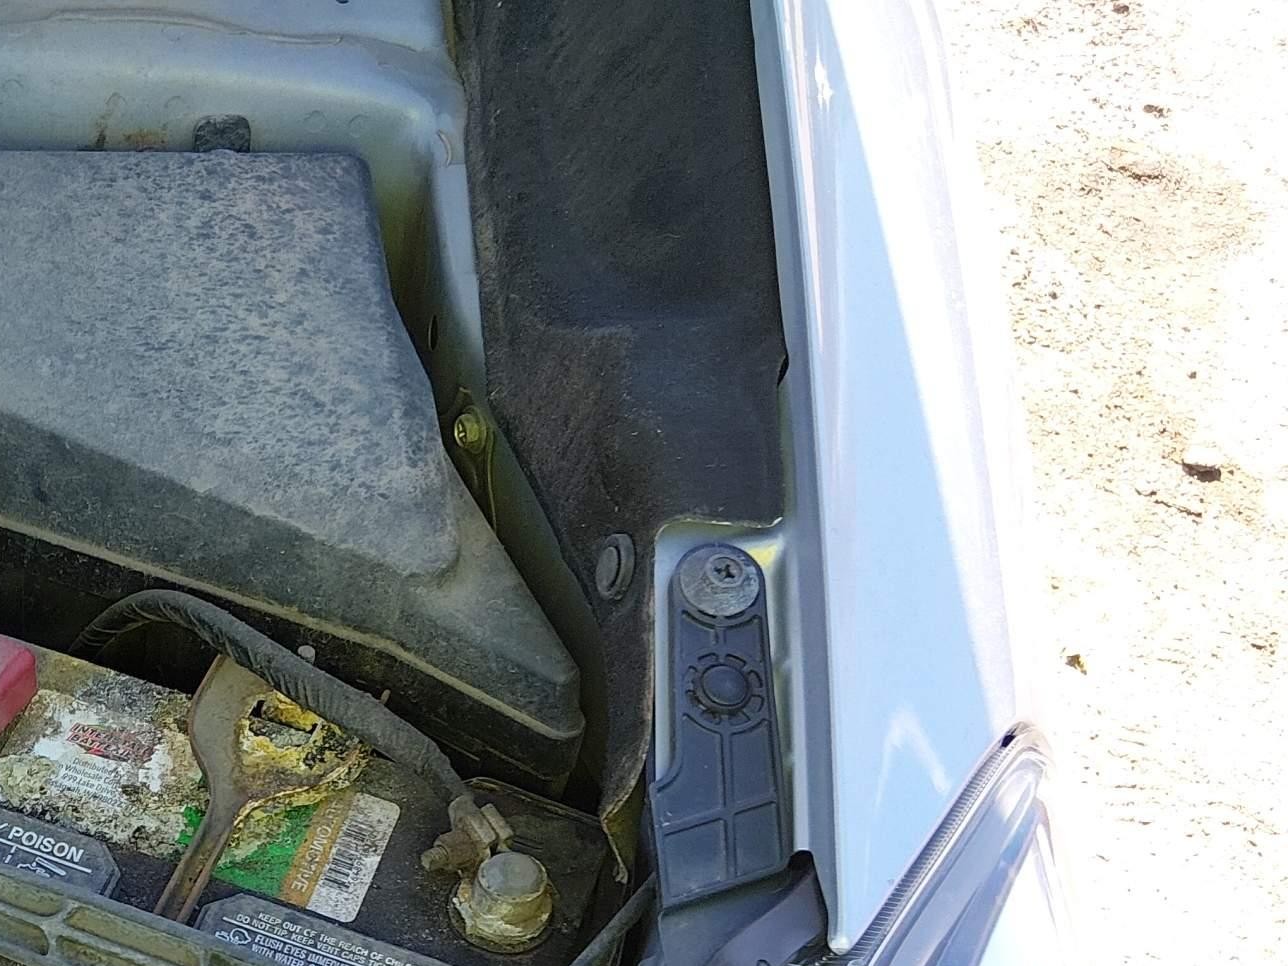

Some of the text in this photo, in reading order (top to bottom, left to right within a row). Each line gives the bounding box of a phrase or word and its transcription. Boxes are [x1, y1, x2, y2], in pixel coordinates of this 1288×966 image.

[8, 826, 84, 863] POISON
[235, 913, 251, 925] DO
[250, 918, 271, 932] NOT
[289, 931, 314, 947] KEEP
[316, 940, 340, 956] VENT
[340, 949, 366, 965] CAPS
[250, 943, 274, 959] WITH
[254, 934, 283, 951] FLUSH
[283, 944, 306, 959] EYES
[257, 911, 282, 927] KEEP
[281, 920, 303, 934] OUT
[302, 927, 317, 939] OF
[318, 932, 337, 946] THE
[337, 939, 369, 957] REACH
[369, 950, 384, 962] OF
